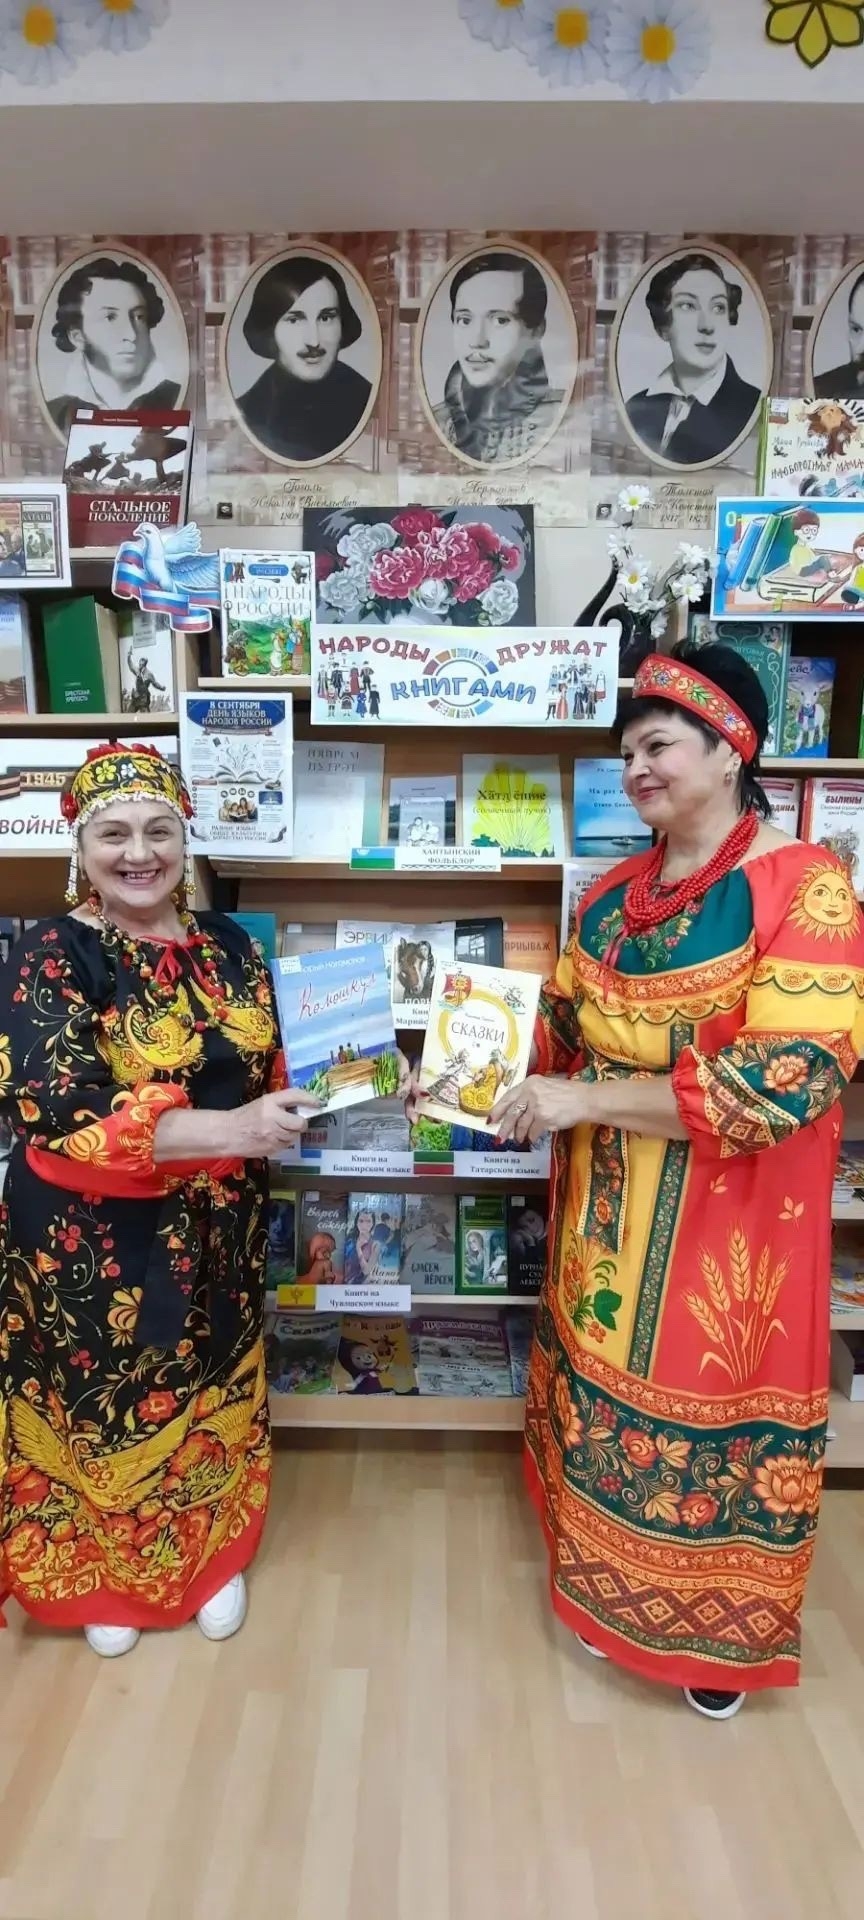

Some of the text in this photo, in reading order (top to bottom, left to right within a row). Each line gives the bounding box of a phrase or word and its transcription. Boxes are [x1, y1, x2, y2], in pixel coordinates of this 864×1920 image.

[89, 500, 171, 513] СТАЛЬНОЕ
[88, 512, 170, 523] ПОКОЛЕНИЕ
[318, 636, 608, 666] НАРОДЫ ДРУЖАТ
[390, 676, 537, 704] КНИГАМИ
[217, 701, 260, 710] СЕНТЯБРЯ
[207, 710, 266, 718] ДЕНЬ ЯЗЫКОВ
[202, 718, 272, 726] НАРОДОВ РОССИИ
[25, 772, 66, 787] 1945
[825, 795, 862, 804] БЫЛИНЫ
[428, 857, 475, 865] ФОЛЬКЛОР
[451, 1020, 505, 1043] СКАЗКИ
[351, 1155, 375, 1164] Книги
[483, 1156, 509, 1165] Книги
[333, 1164, 384, 1173] Башкирском
[470, 1165, 540, 1175] Татарском языке
[344, 1289, 369, 1297] Книги
[329, 1299, 374, 1308] Чувашском
